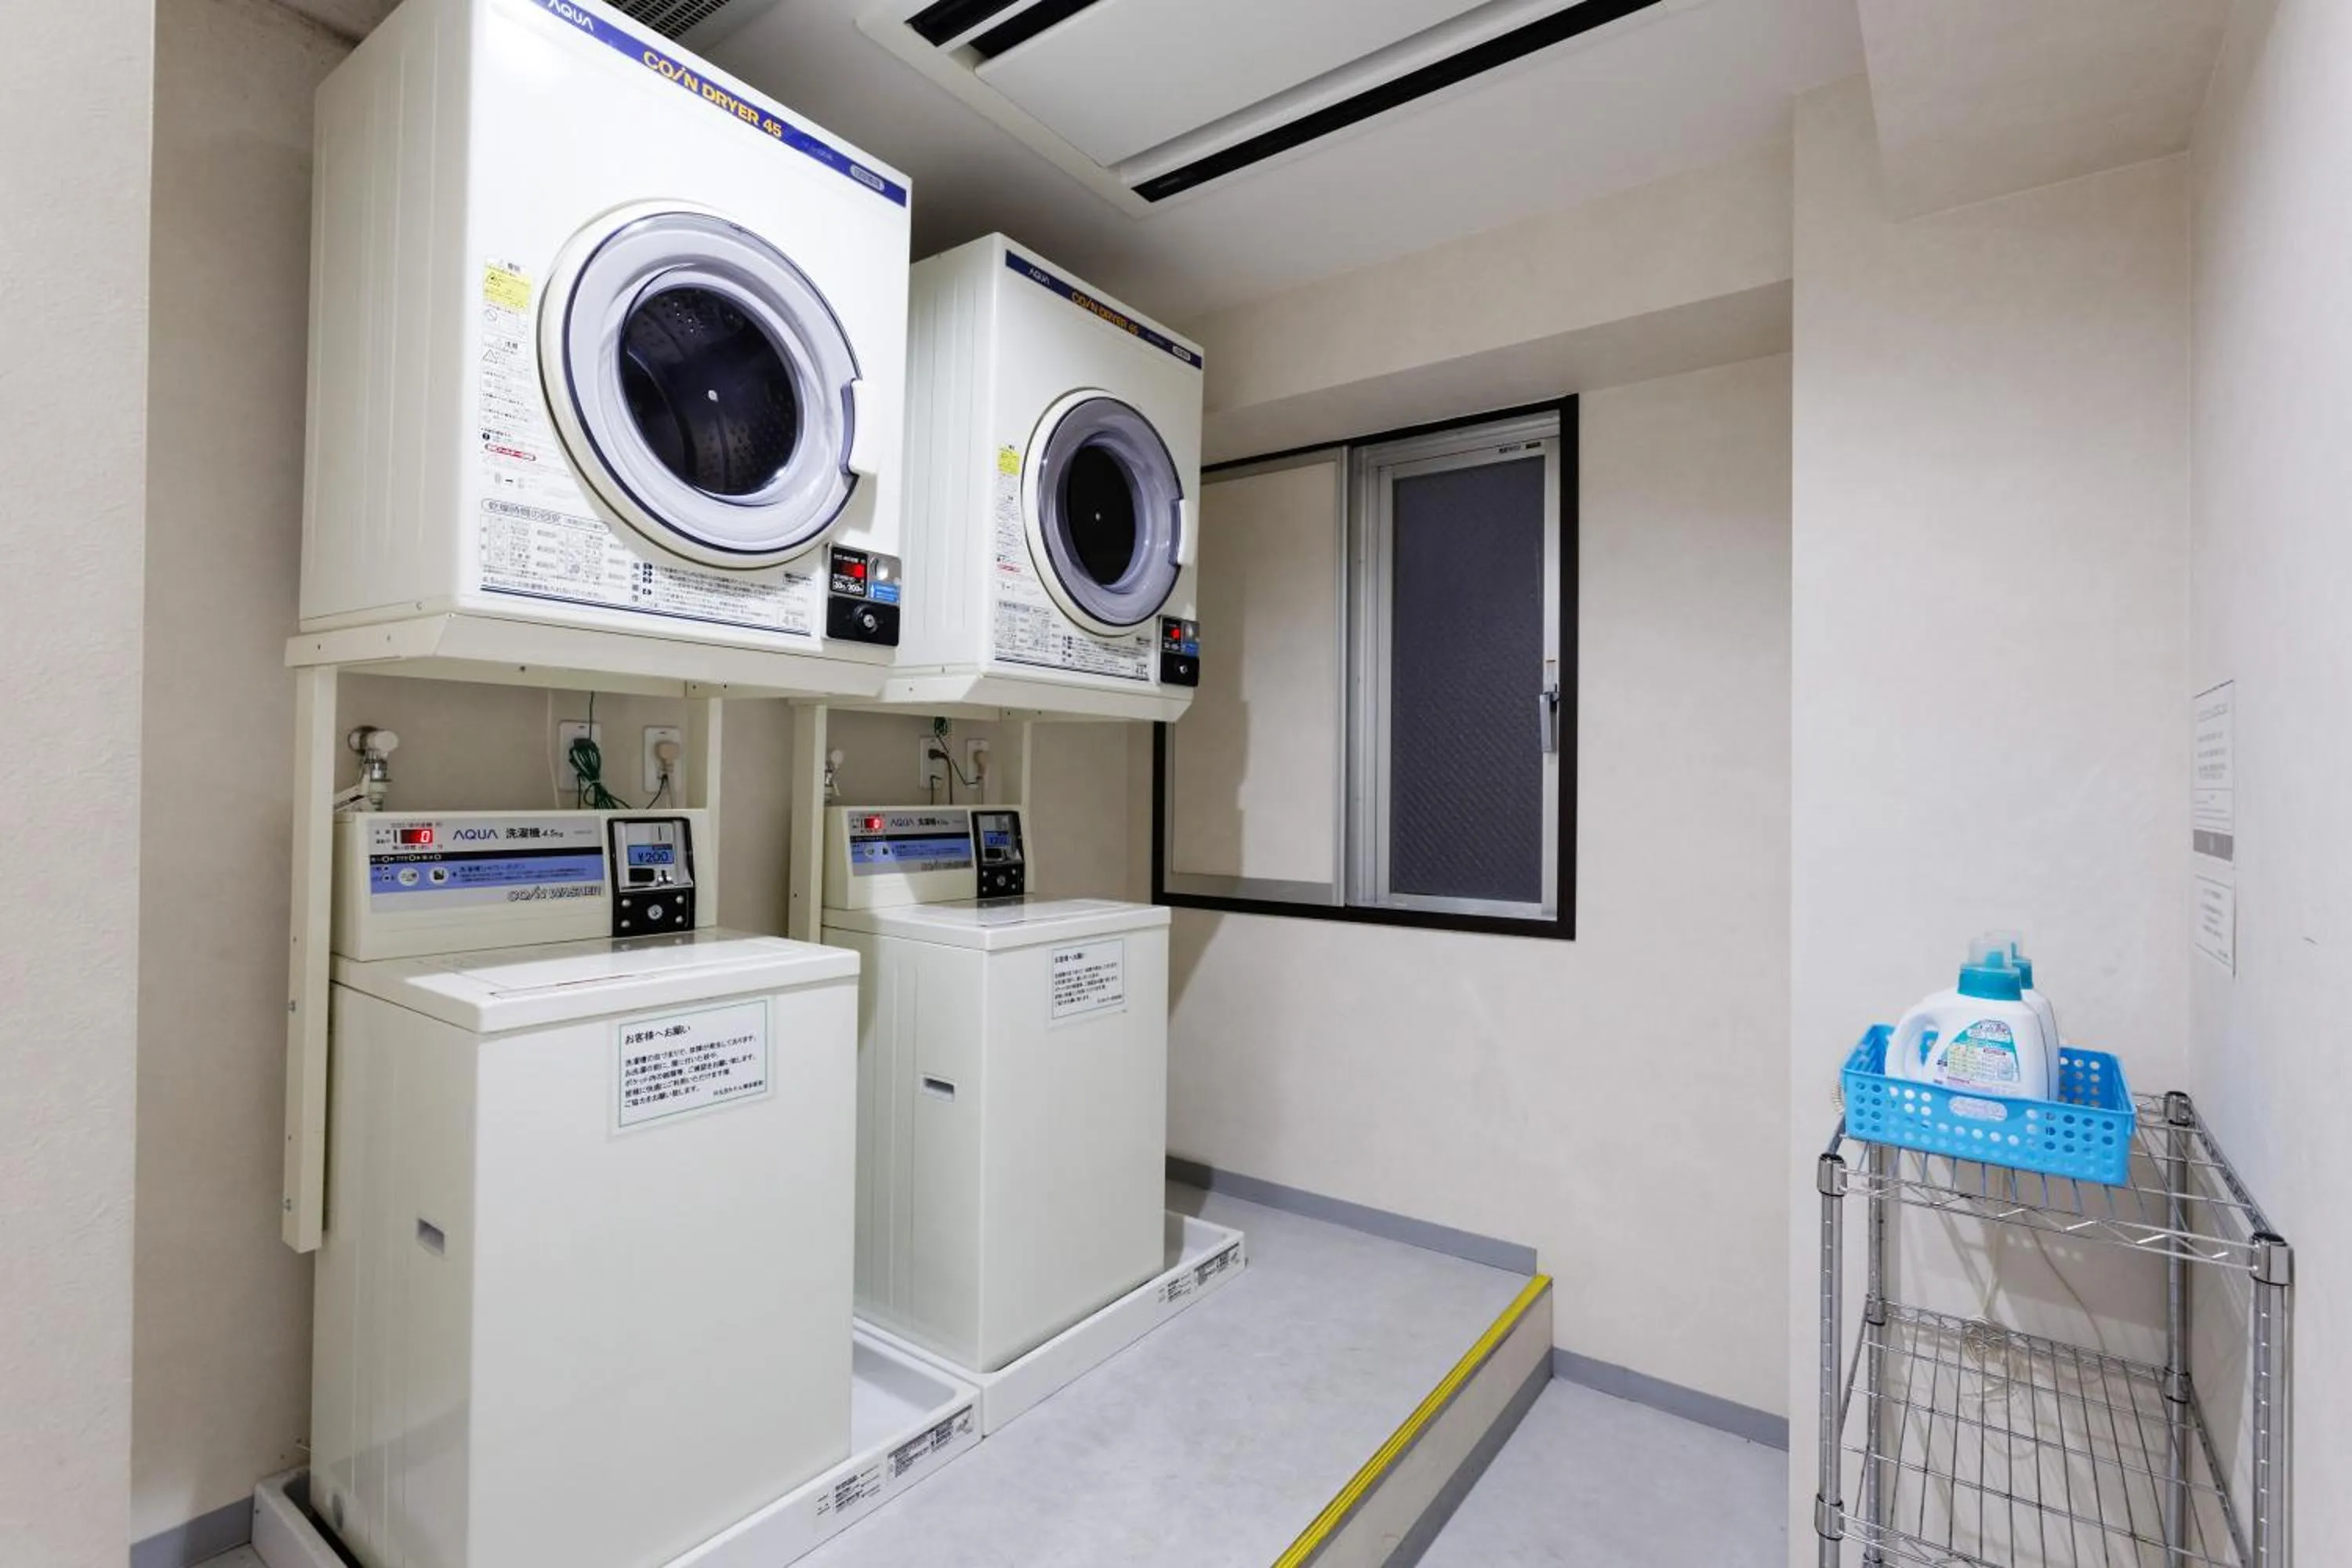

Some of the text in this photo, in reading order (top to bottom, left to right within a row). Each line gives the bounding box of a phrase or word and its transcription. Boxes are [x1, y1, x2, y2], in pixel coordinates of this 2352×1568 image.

[548, 0, 594, 32] AQUA
[642, 50, 782, 138] COIN DRYER 45
[1071, 291, 1098, 314] COIN
[1099, 305, 1127, 330] DRYER
[420, 829, 431, 844] 0
[452, 828, 499, 840] AQUA
[626, 1025, 691, 1045] お客様へお願い
